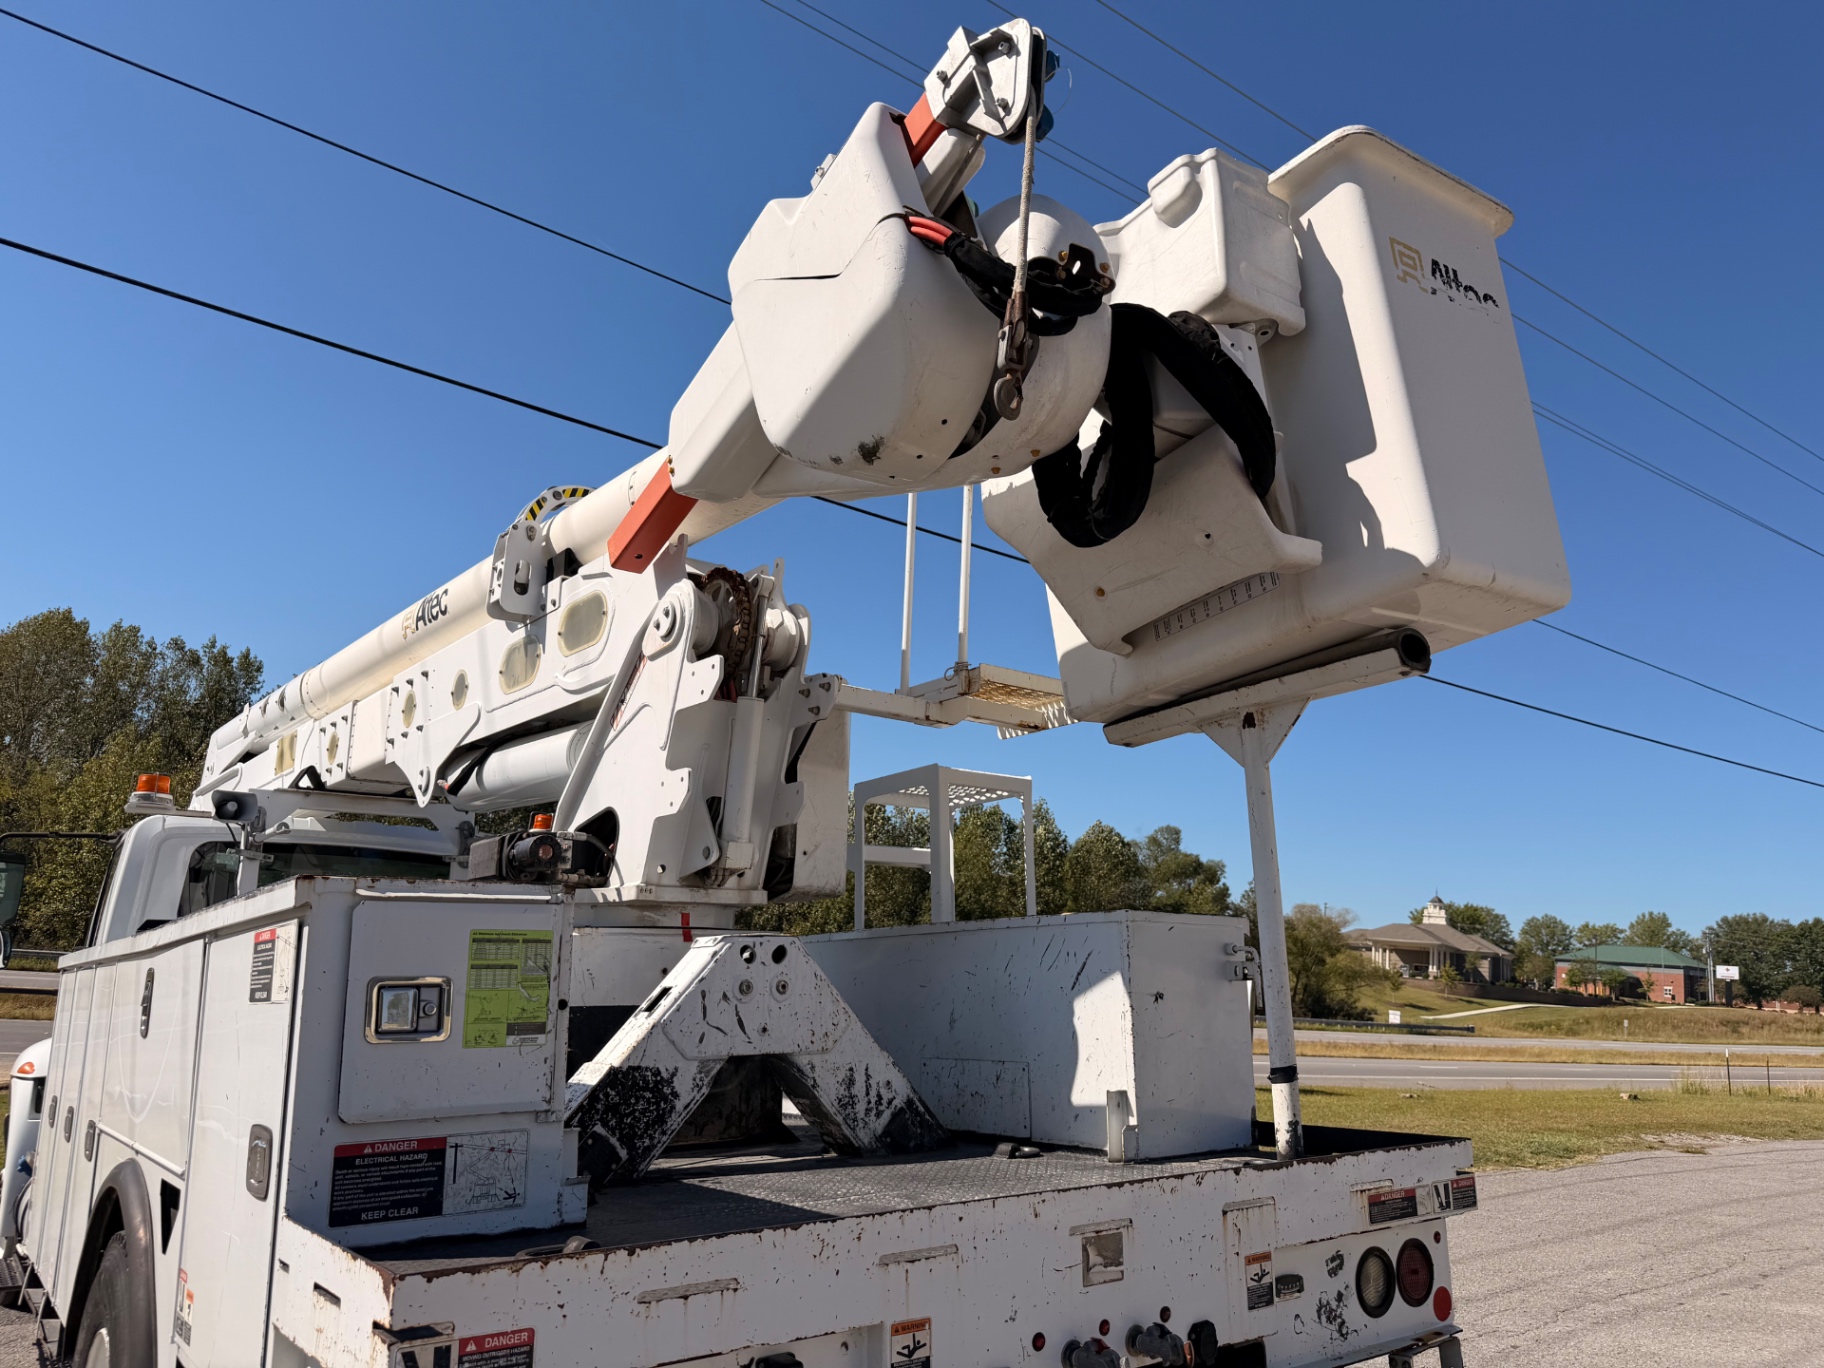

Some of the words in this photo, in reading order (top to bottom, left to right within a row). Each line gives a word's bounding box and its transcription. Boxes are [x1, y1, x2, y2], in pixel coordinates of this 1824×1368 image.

[415, 588, 448, 631] Altec
[375, 1141, 418, 1152] DANGER
[355, 1156, 398, 1165] ELECTRICAL
[400, 1153, 428, 1162] HAZARD
[361, 1211, 386, 1220] KEEP
[388, 1206, 419, 1217] CLEAR
[485, 1332, 528, 1348] DANGER
